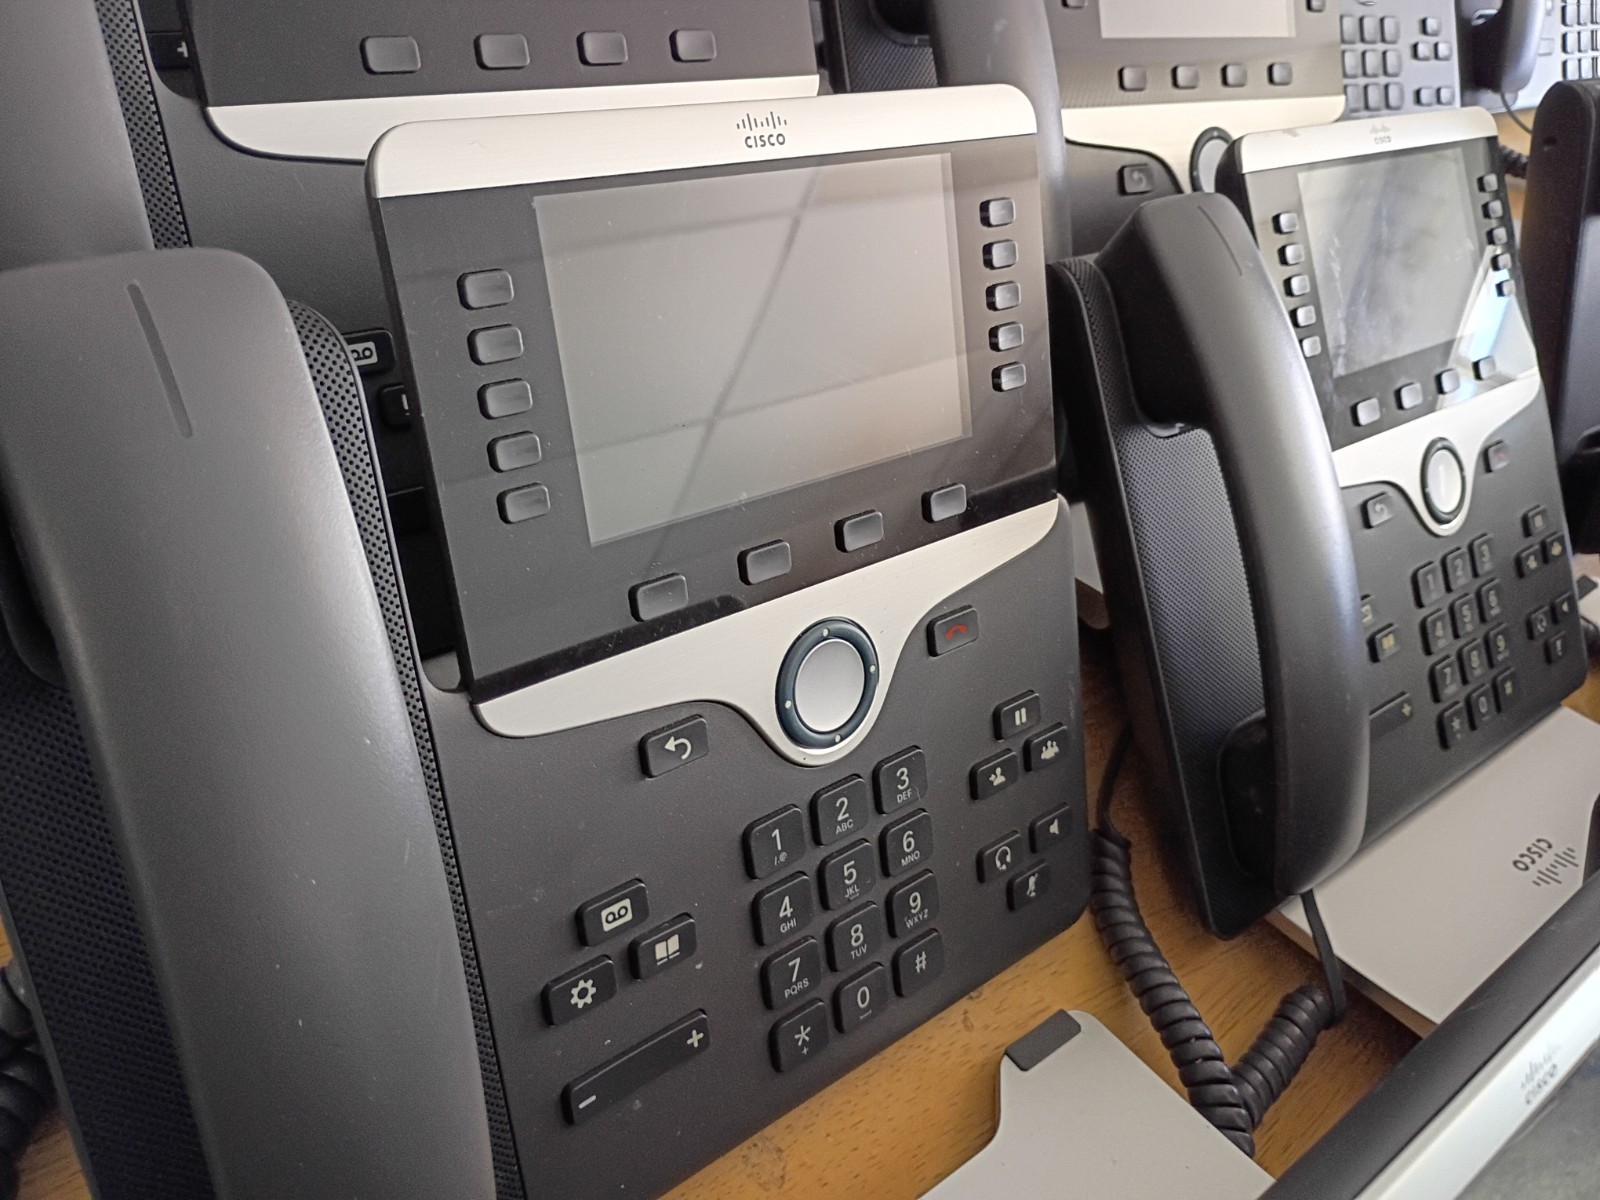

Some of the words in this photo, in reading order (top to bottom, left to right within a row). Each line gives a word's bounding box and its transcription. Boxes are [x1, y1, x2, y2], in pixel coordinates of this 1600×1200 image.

[744, 133, 786, 149] CISCO
[1455, 559, 1463, 576] 2
[896, 767, 909, 791] 3
[896, 789, 913, 803] DEF
[836, 797, 849, 821] 2
[835, 819, 854, 835] ABC
[771, 828, 782, 851] 1
[902, 830, 915, 852] 6
[901, 851, 921, 867] MNO
[1512, 838, 1553, 871] CISCO
[843, 861, 857, 885] 5
[845, 885, 860, 898] JKL
[779, 895, 793, 918] 4
[909, 892, 922, 914] 9
[779, 918, 797, 933] GHI
[905, 910, 929, 928] WXYZ
[850, 924, 864, 947] 8
[851, 944, 868, 959] TUV
[788, 957, 801, 982] 7
[784, 978, 809, 999] PQRS
[857, 986, 870, 1009] 0
